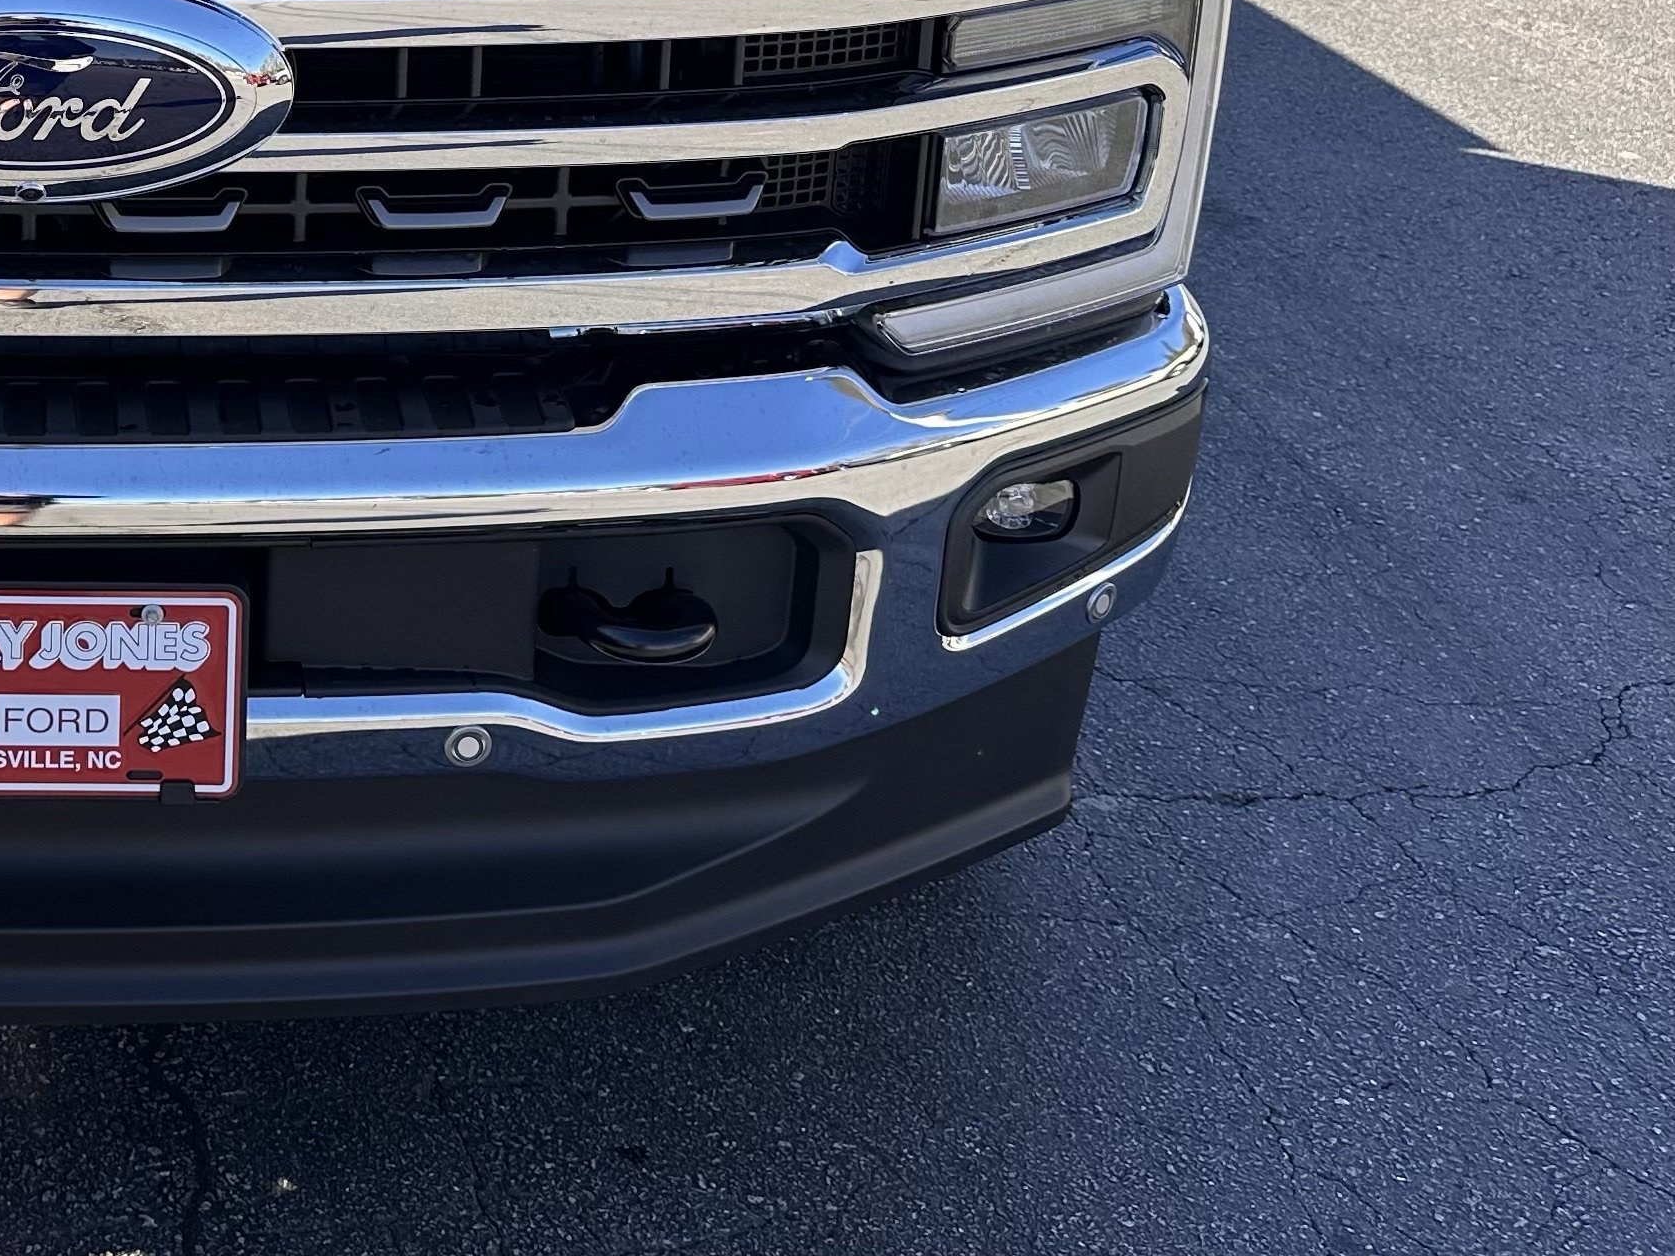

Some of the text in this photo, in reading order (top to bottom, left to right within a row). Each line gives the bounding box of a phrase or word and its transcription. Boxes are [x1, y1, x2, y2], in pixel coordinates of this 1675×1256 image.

[28, 620, 211, 672] JONES
[4, 707, 109, 734] FORD
[87, 750, 122, 769] NC
